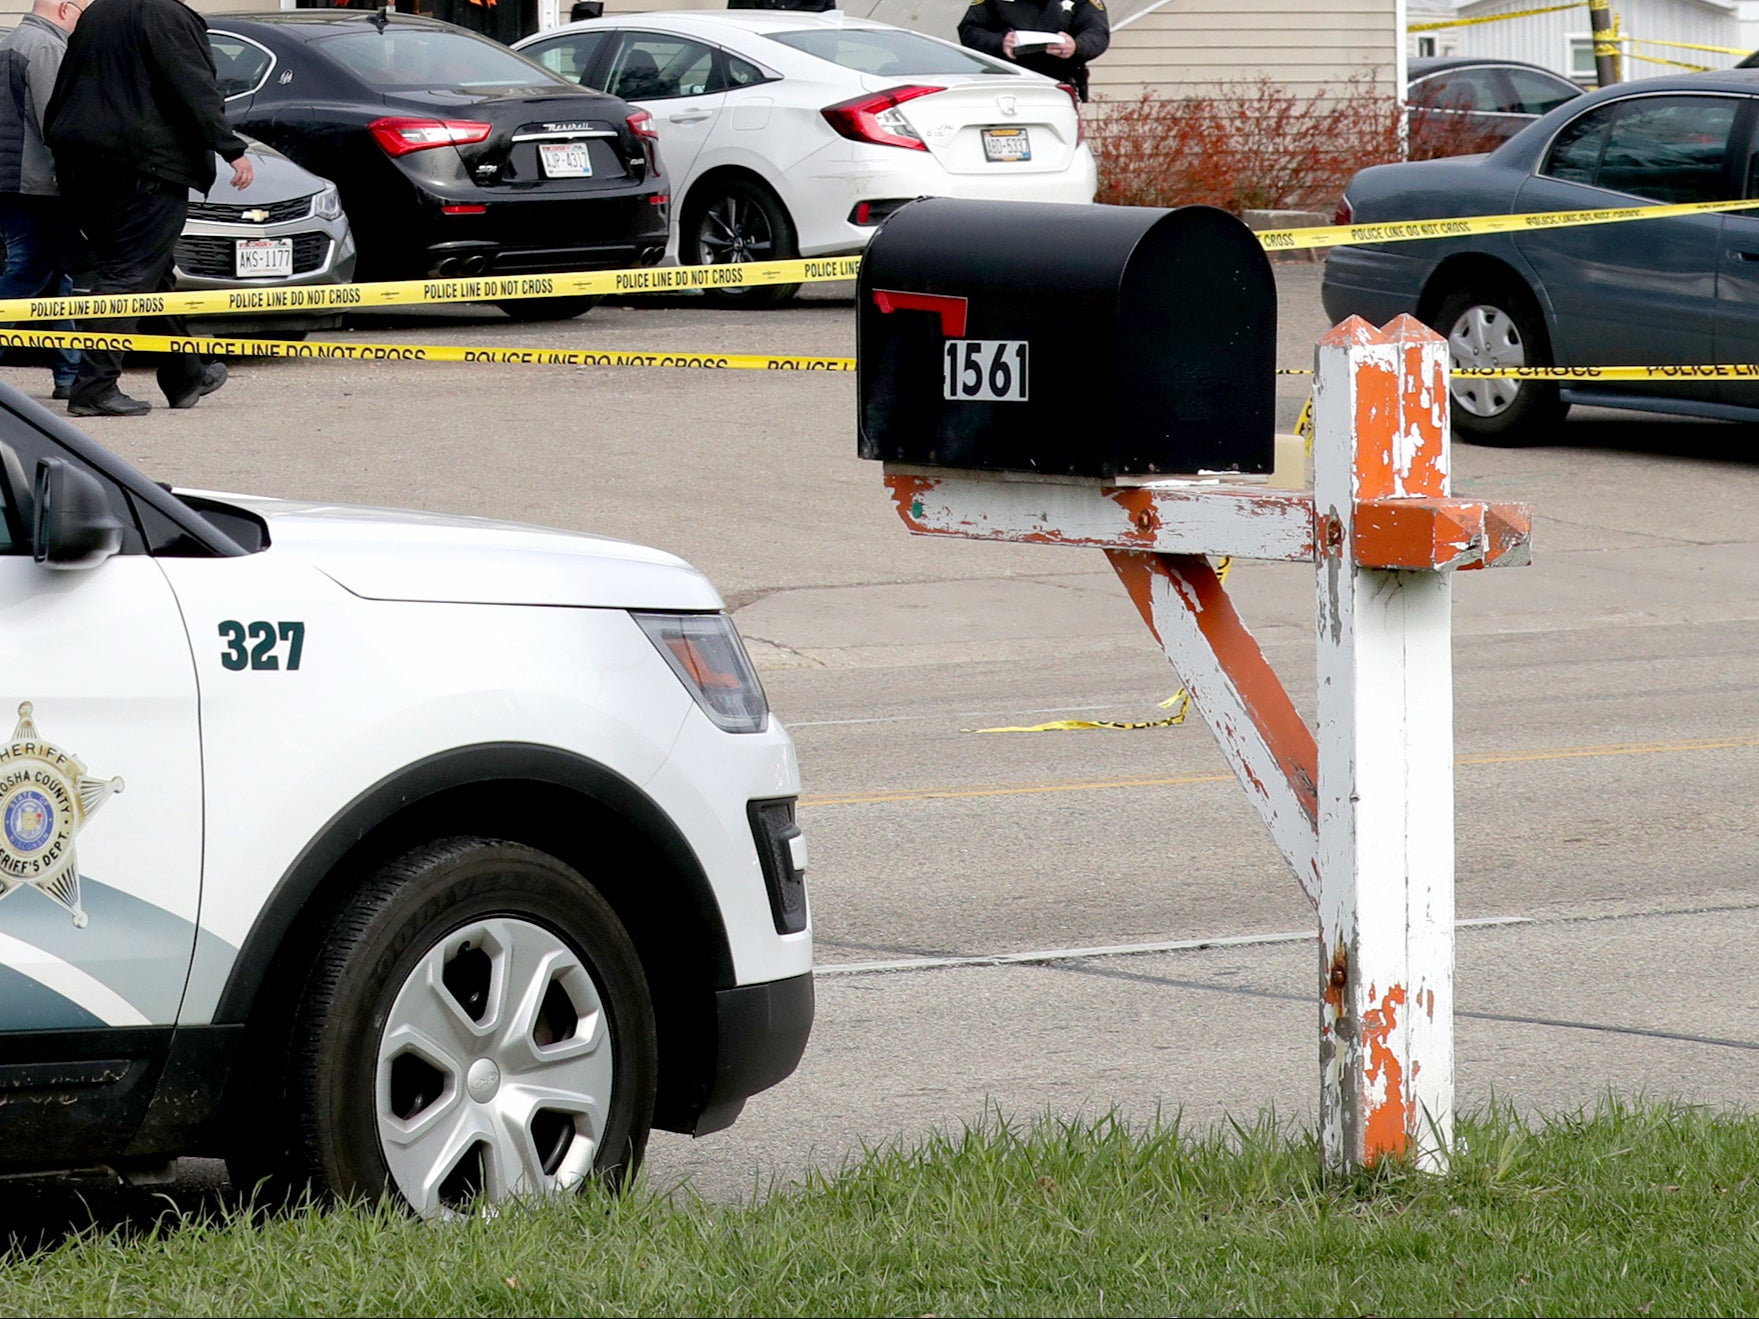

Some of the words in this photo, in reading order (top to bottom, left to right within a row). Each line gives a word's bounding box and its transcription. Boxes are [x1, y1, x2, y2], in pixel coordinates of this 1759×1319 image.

[1264, 233, 1295, 248] CROSS
[1351, 225, 1383, 241] POLICE
[1385, 225, 1405, 239] LINE
[1407, 224, 1419, 237] DO
[1421, 222, 1441, 236] NOT
[1443, 221, 1471, 235] CROSS
[240, 250, 290, 268] AKS-1177
[616, 274, 649, 289] POLICE
[652, 272, 672, 287] LINE
[675, 271, 688, 286] DO
[691, 270, 709, 285] NOT
[712, 268, 743, 283] CROSS
[805, 262, 837, 278] POLICE
[229, 293, 263, 308] POLICE
[266, 291, 288, 307] LINE
[291, 290, 304, 305] DO
[307, 289, 326, 304] NOT
[329, 288, 361, 303] CROSS
[424, 283, 457, 299] POLICE
[460, 282, 481, 297] LINE
[484, 281, 497, 296] DO
[500, 280, 519, 295] NOT
[522, 279, 553, 294] CROSS
[30, 302, 65, 317] POLICE
[68, 300, 90, 316] LINE
[93, 299, 106, 314] DO
[109, 298, 129, 313] NOT
[131, 297, 164, 313] CROSS
[947, 342, 1027, 398] 1561
[218, 620, 305, 671] 327
[34, 771, 71, 813] COUNTY
[43, 831, 70, 867] DEPT.
